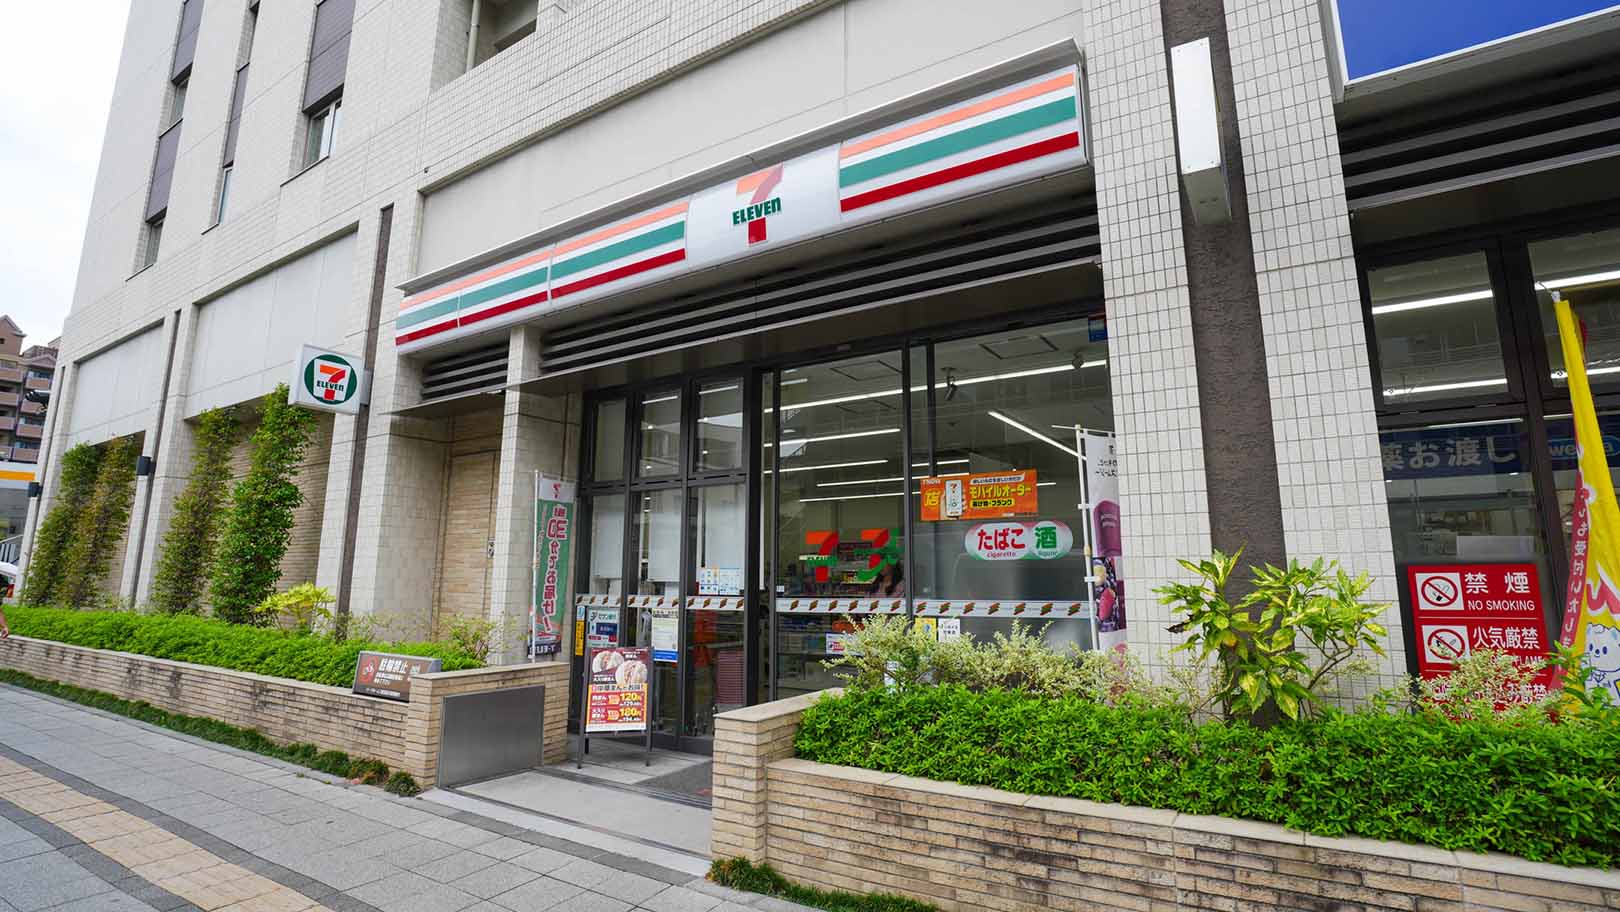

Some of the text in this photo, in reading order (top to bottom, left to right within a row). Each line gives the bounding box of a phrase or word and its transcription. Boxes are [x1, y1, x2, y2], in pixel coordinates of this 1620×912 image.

[969, 484, 1032, 498] モバイルオーダー
[978, 526, 1057, 551] たばこ 酒
[1467, 600, 1535, 611] NO SMOKING
[1472, 626, 1540, 649] 火気厳禁
